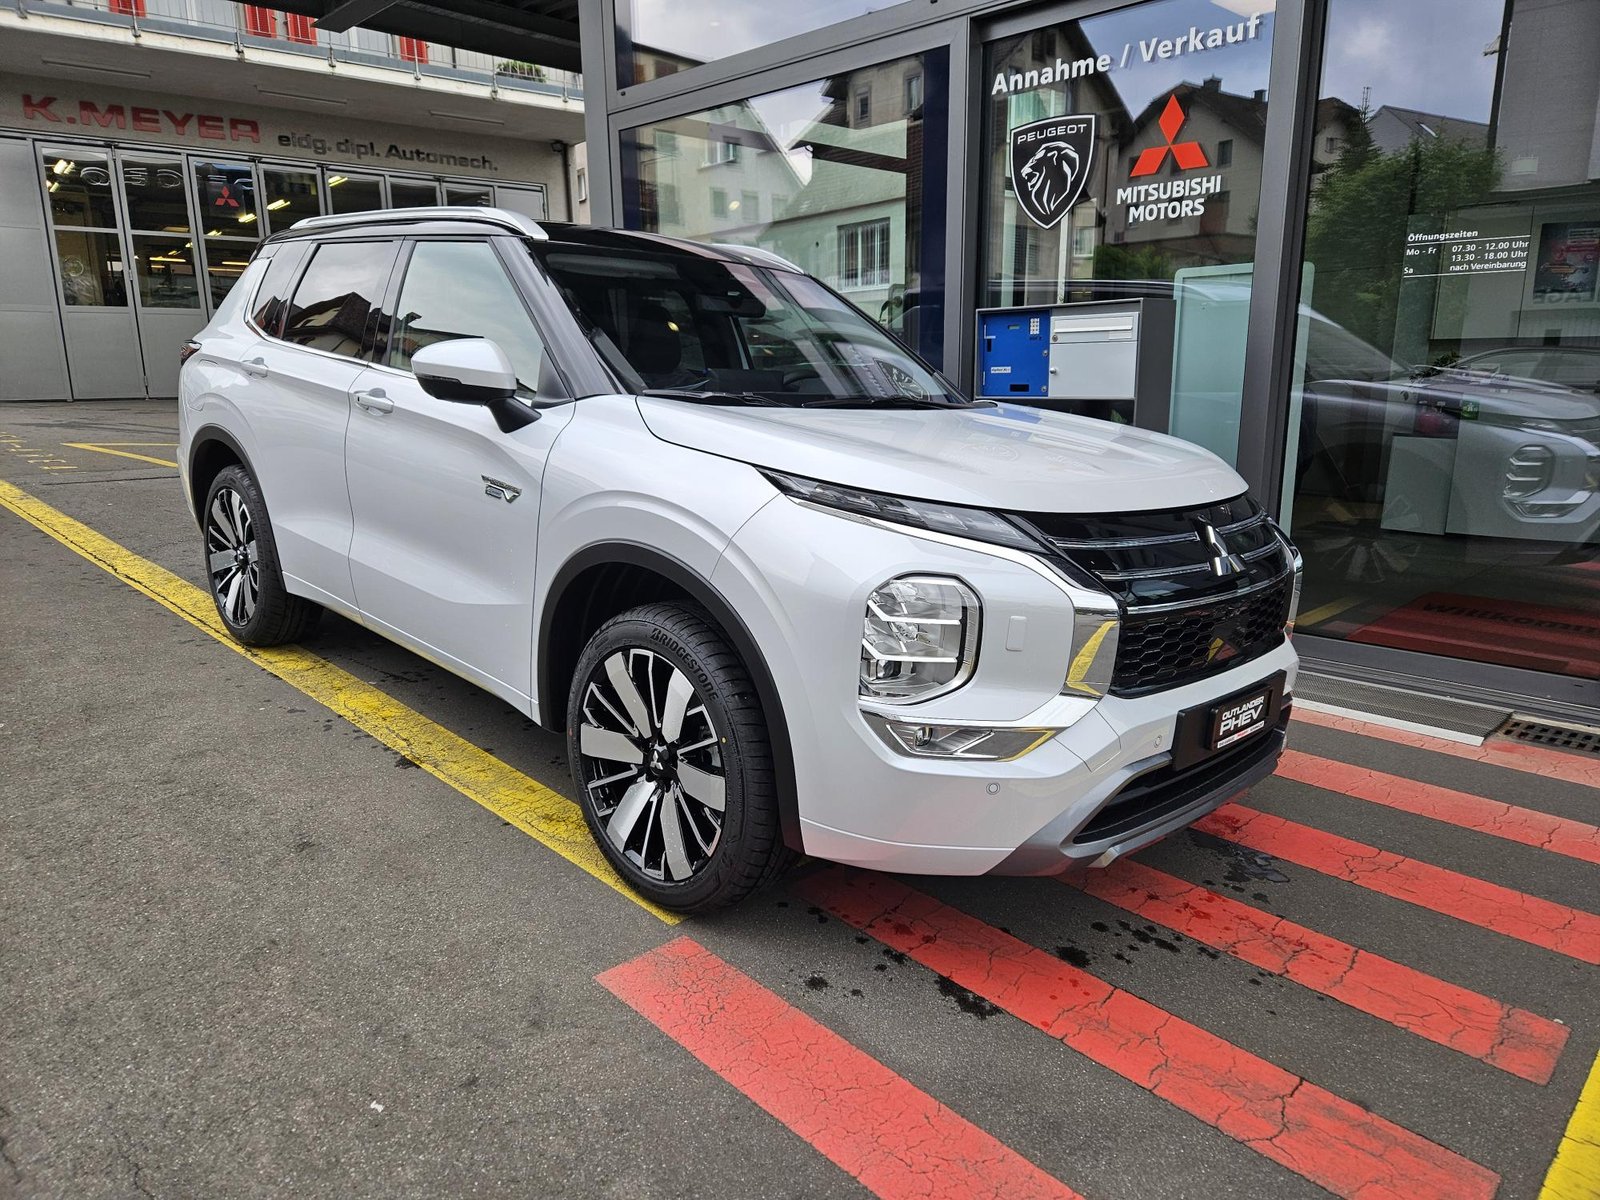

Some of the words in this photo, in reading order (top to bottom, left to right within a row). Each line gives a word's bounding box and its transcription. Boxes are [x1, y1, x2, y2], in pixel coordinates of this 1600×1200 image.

[991, 53, 1112, 96] Annahme
[1119, 43, 1131, 69] /
[1139, 12, 1261, 63] Verkauf
[22, 94, 260, 143] K.MEYER
[278, 132, 333, 156] eidg.
[336, 138, 380, 160] dipl.
[384, 143, 499, 172] Automech.
[1016, 123, 1088, 145] PEUGEOT
[1116, 174, 1222, 205] MITSUBISHI
[1128, 197, 1205, 223] MOTORS
[1406, 248, 1420, 256] Mo
[1427, 246, 1437, 254] Fr
[1451, 243, 1477, 253] 07.30
[1485, 241, 1510, 250] 12.00
[1512, 240, 1530, 249] Uhr
[1407, 230, 1479, 242] Öffnungszeiten
[1403, 266, 1414, 274] Sa
[1449, 263, 1469, 271] nach
[1470, 261, 1527, 270] Vereinbarung
[1451, 253, 1475, 262] 13.30
[1484, 251, 1508, 260] 18.00
[1510, 250, 1528, 258] Uhr
[650, 627, 718, 701] BRIDGESTONE
[1219, 705, 1263, 735] PHEV
[1222, 695, 1265, 720] OUTLANDER
